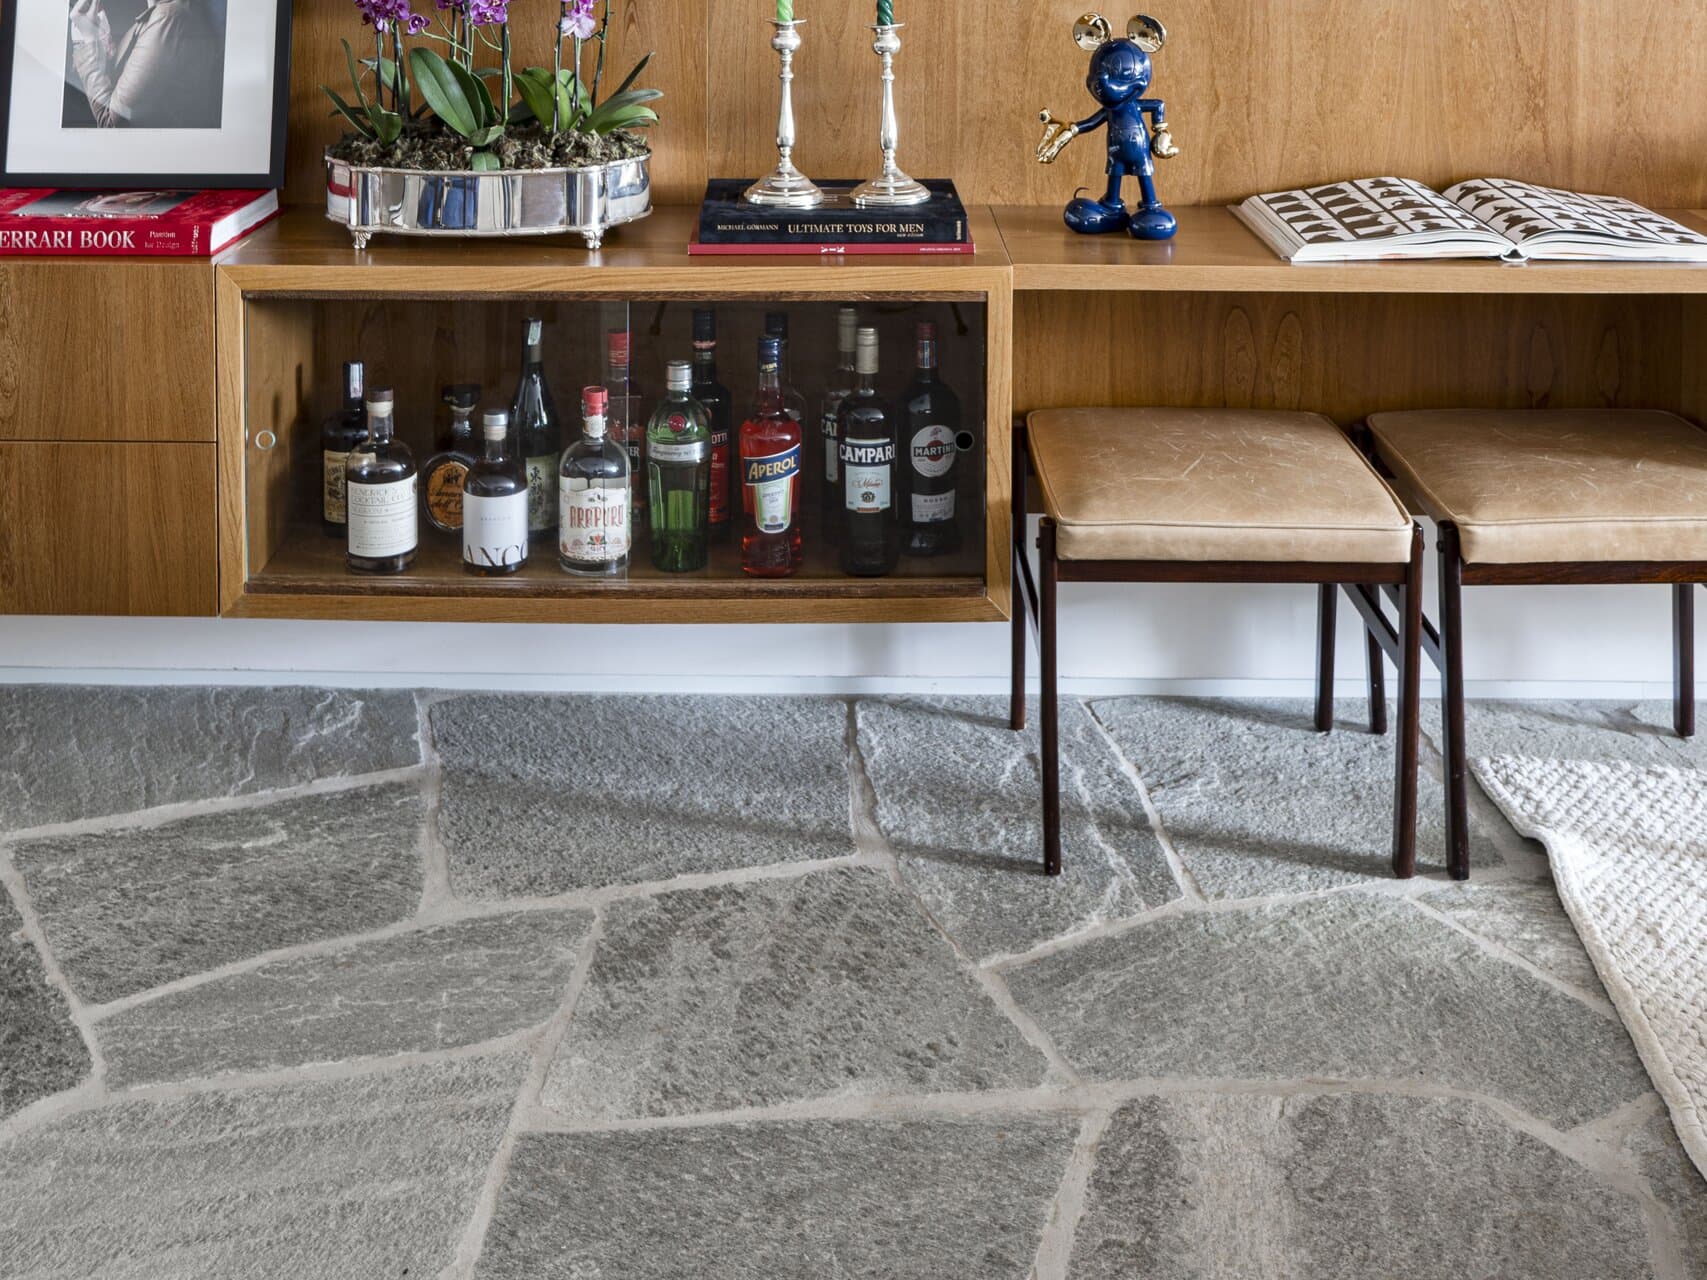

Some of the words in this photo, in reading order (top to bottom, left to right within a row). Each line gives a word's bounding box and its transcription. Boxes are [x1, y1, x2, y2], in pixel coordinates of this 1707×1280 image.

[788, 223, 844, 233] ULTIMATE
[846, 223, 873, 233] TOYS
[875, 223, 897, 233] FOR
[899, 223, 924, 233] MEN
[0, 230, 73, 249] ERRARI
[80, 230, 136, 249] BOOK
[839, 443, 896, 464] CAMPARI
[914, 443, 955, 457] MARTINI
[748, 455, 797, 481] APEROL
